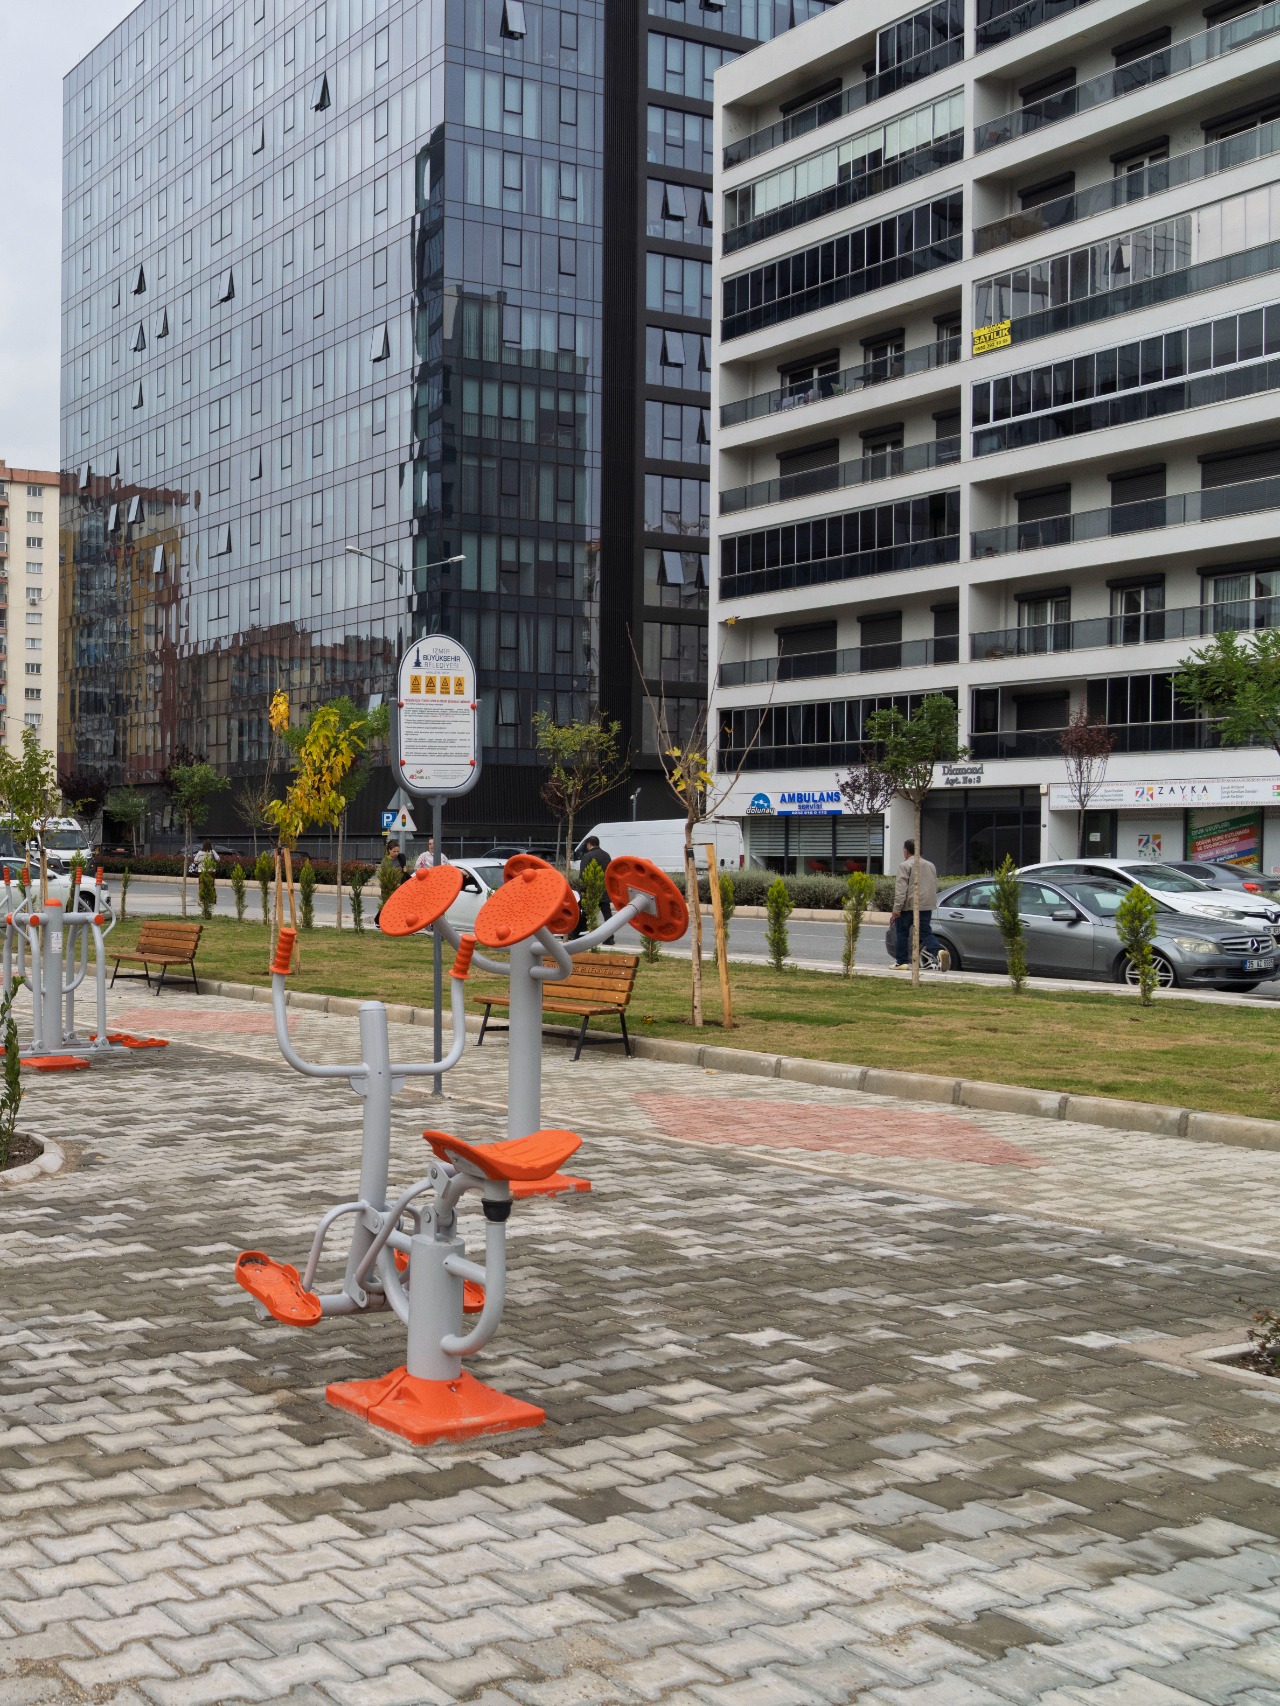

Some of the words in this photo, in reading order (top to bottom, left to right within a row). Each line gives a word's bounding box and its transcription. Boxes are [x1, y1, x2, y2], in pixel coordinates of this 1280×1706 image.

[974, 327, 1010, 345] SATILIK
[941, 764, 984, 776] Diamond
[944, 776, 961, 786] Apt.
[1158, 785, 1208, 795] ZAYKA
[780, 791, 841, 804] AMBULANS
[384, 813, 393, 827] P
